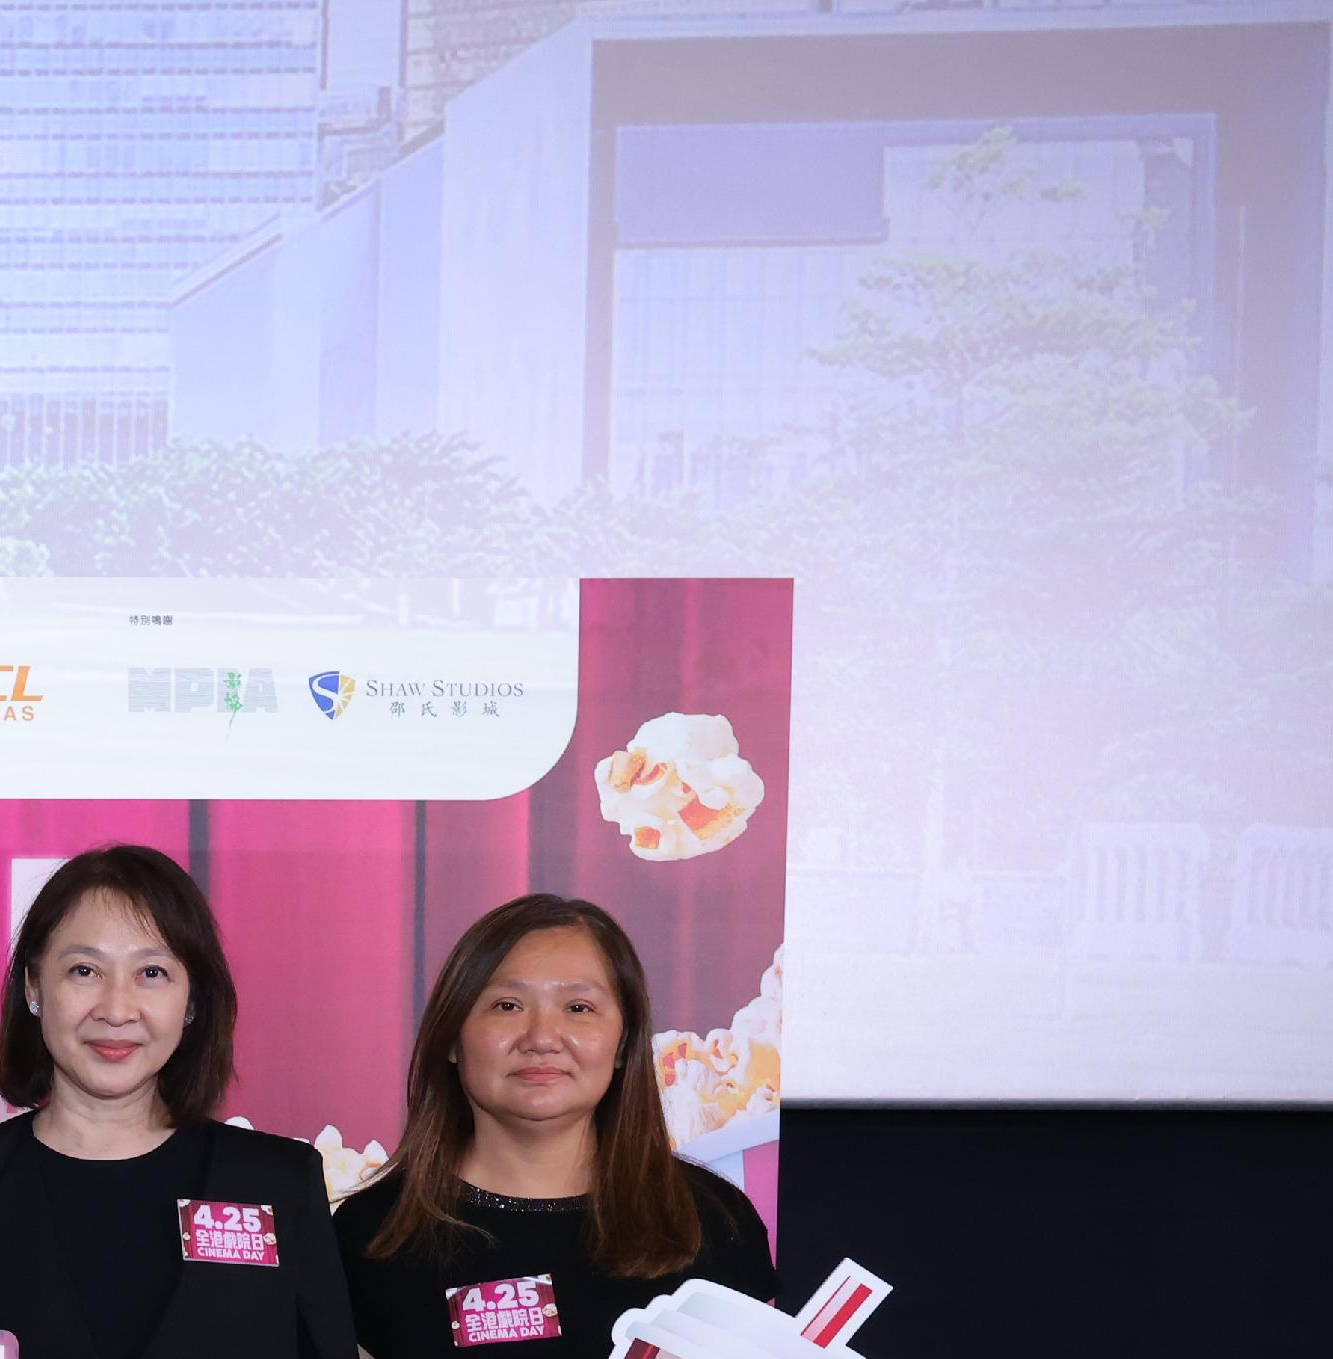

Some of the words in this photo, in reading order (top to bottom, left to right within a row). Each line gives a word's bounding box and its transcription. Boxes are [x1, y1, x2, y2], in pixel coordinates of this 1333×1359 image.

[129, 615, 173, 626] 特別鳴謝
[366, 680, 426, 697] SHAW
[432, 680, 524, 697] STUDIOS
[194, 1205, 262, 1232] 4.25
[195, 1229, 264, 1251] 全港戲院日
[197, 1247, 241, 1259] CINEMA
[243, 1251, 265, 1260] DAY
[462, 1281, 539, 1312] 4.25
[465, 1307, 544, 1333] 全港戲院日
[468, 1328, 517, 1342] CINEMA
[520, 1326, 545, 1337] DAY
